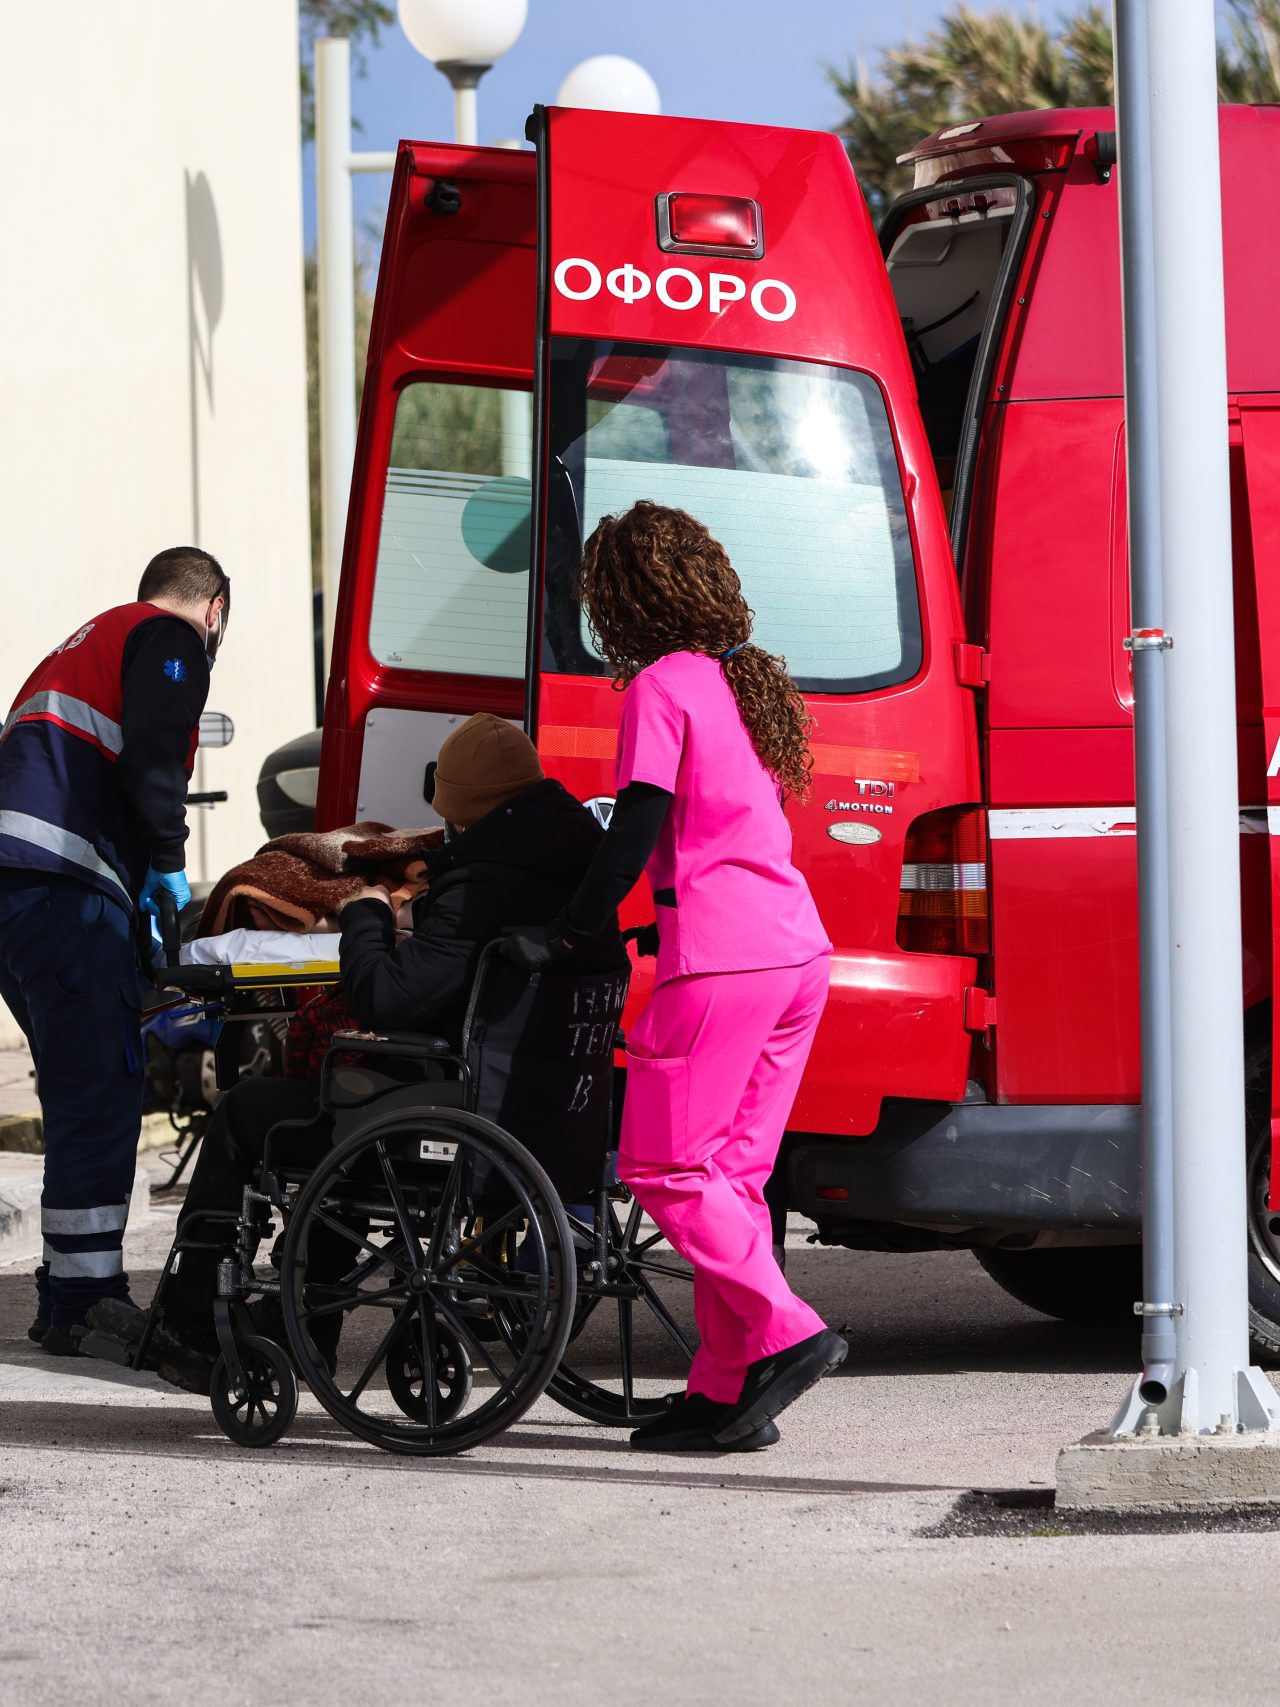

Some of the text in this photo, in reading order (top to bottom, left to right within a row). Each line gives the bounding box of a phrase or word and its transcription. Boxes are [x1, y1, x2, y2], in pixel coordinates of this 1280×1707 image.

[553, 257, 797, 322] ΟΦΟΡΟ
[854, 779, 895, 797] TDI
[824, 799, 894, 814] 4MOTION
